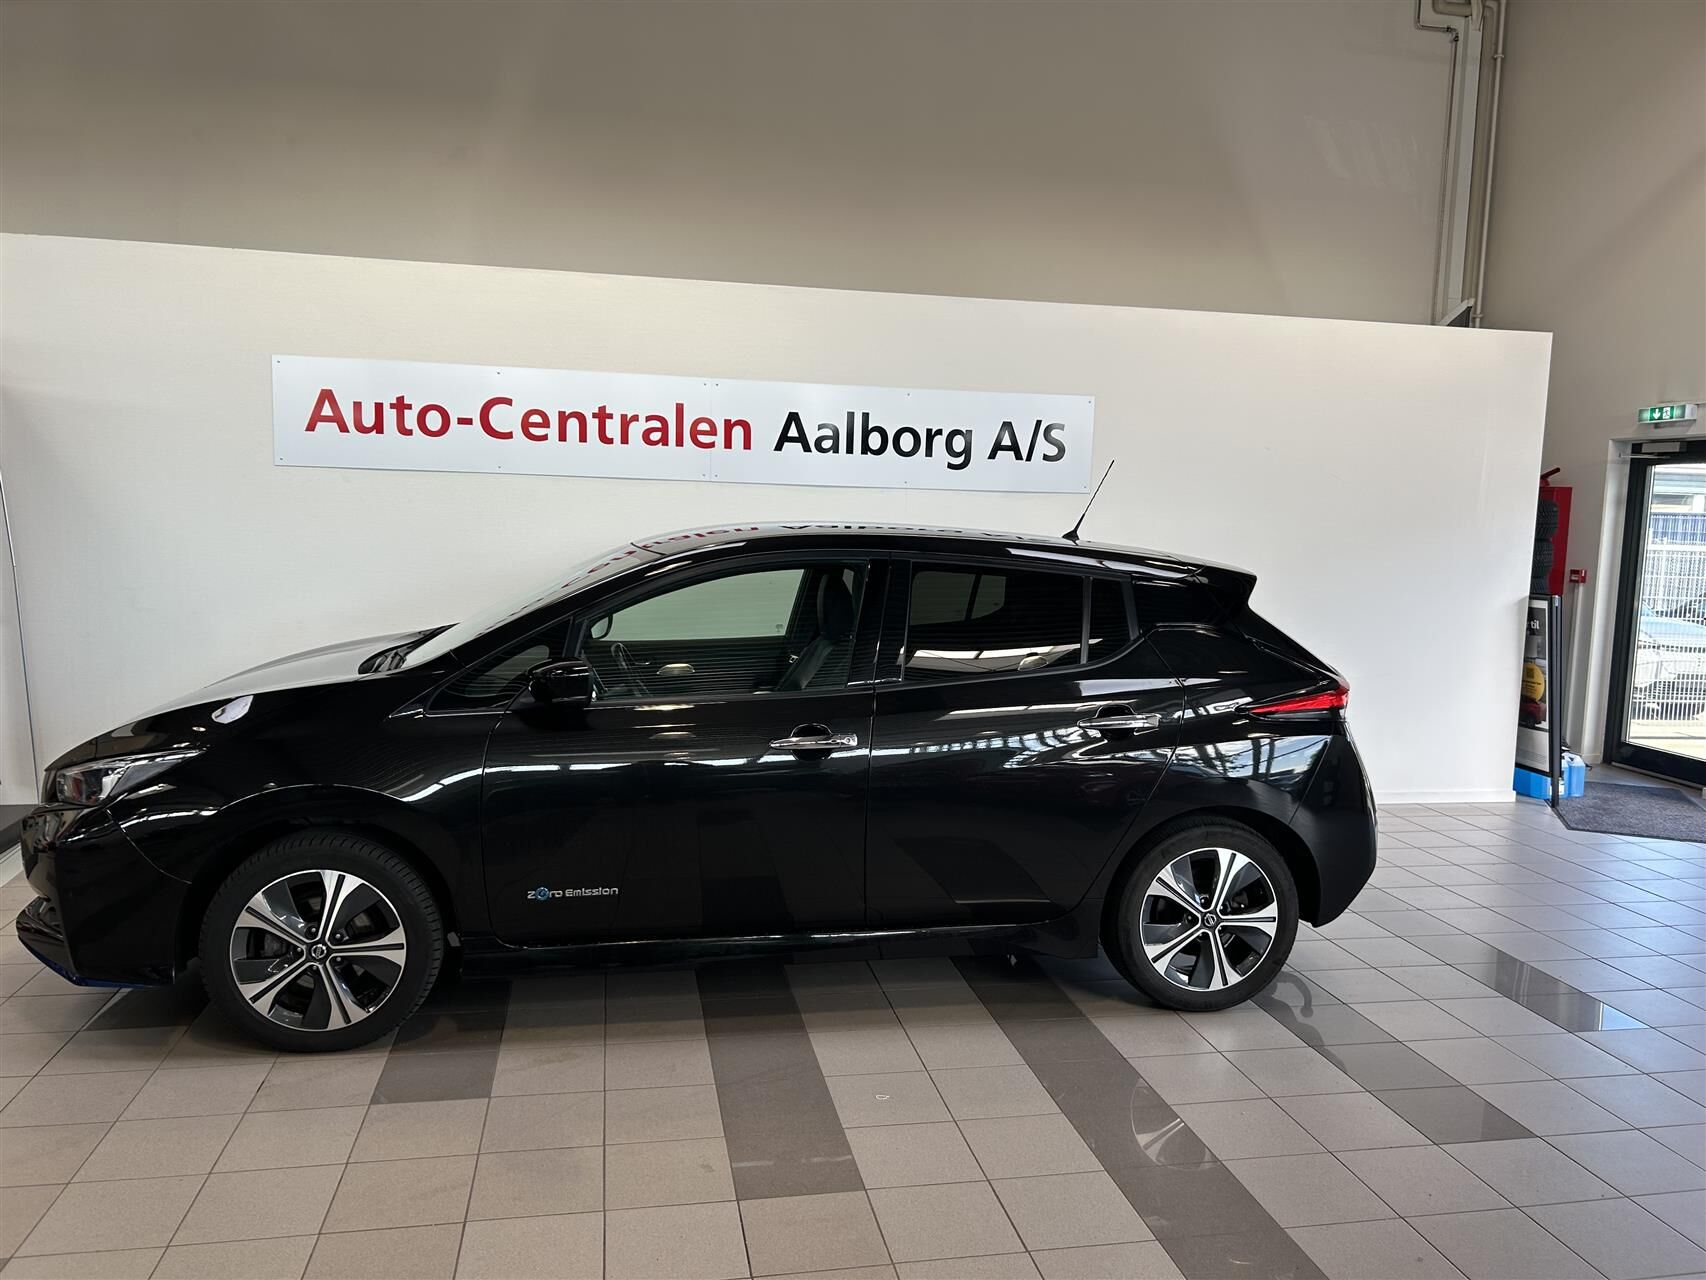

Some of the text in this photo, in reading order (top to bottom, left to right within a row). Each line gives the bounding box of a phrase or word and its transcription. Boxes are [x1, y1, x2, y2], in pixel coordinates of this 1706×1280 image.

[305, 389, 1067, 471] Auto-Centralen Aalborg A/S
